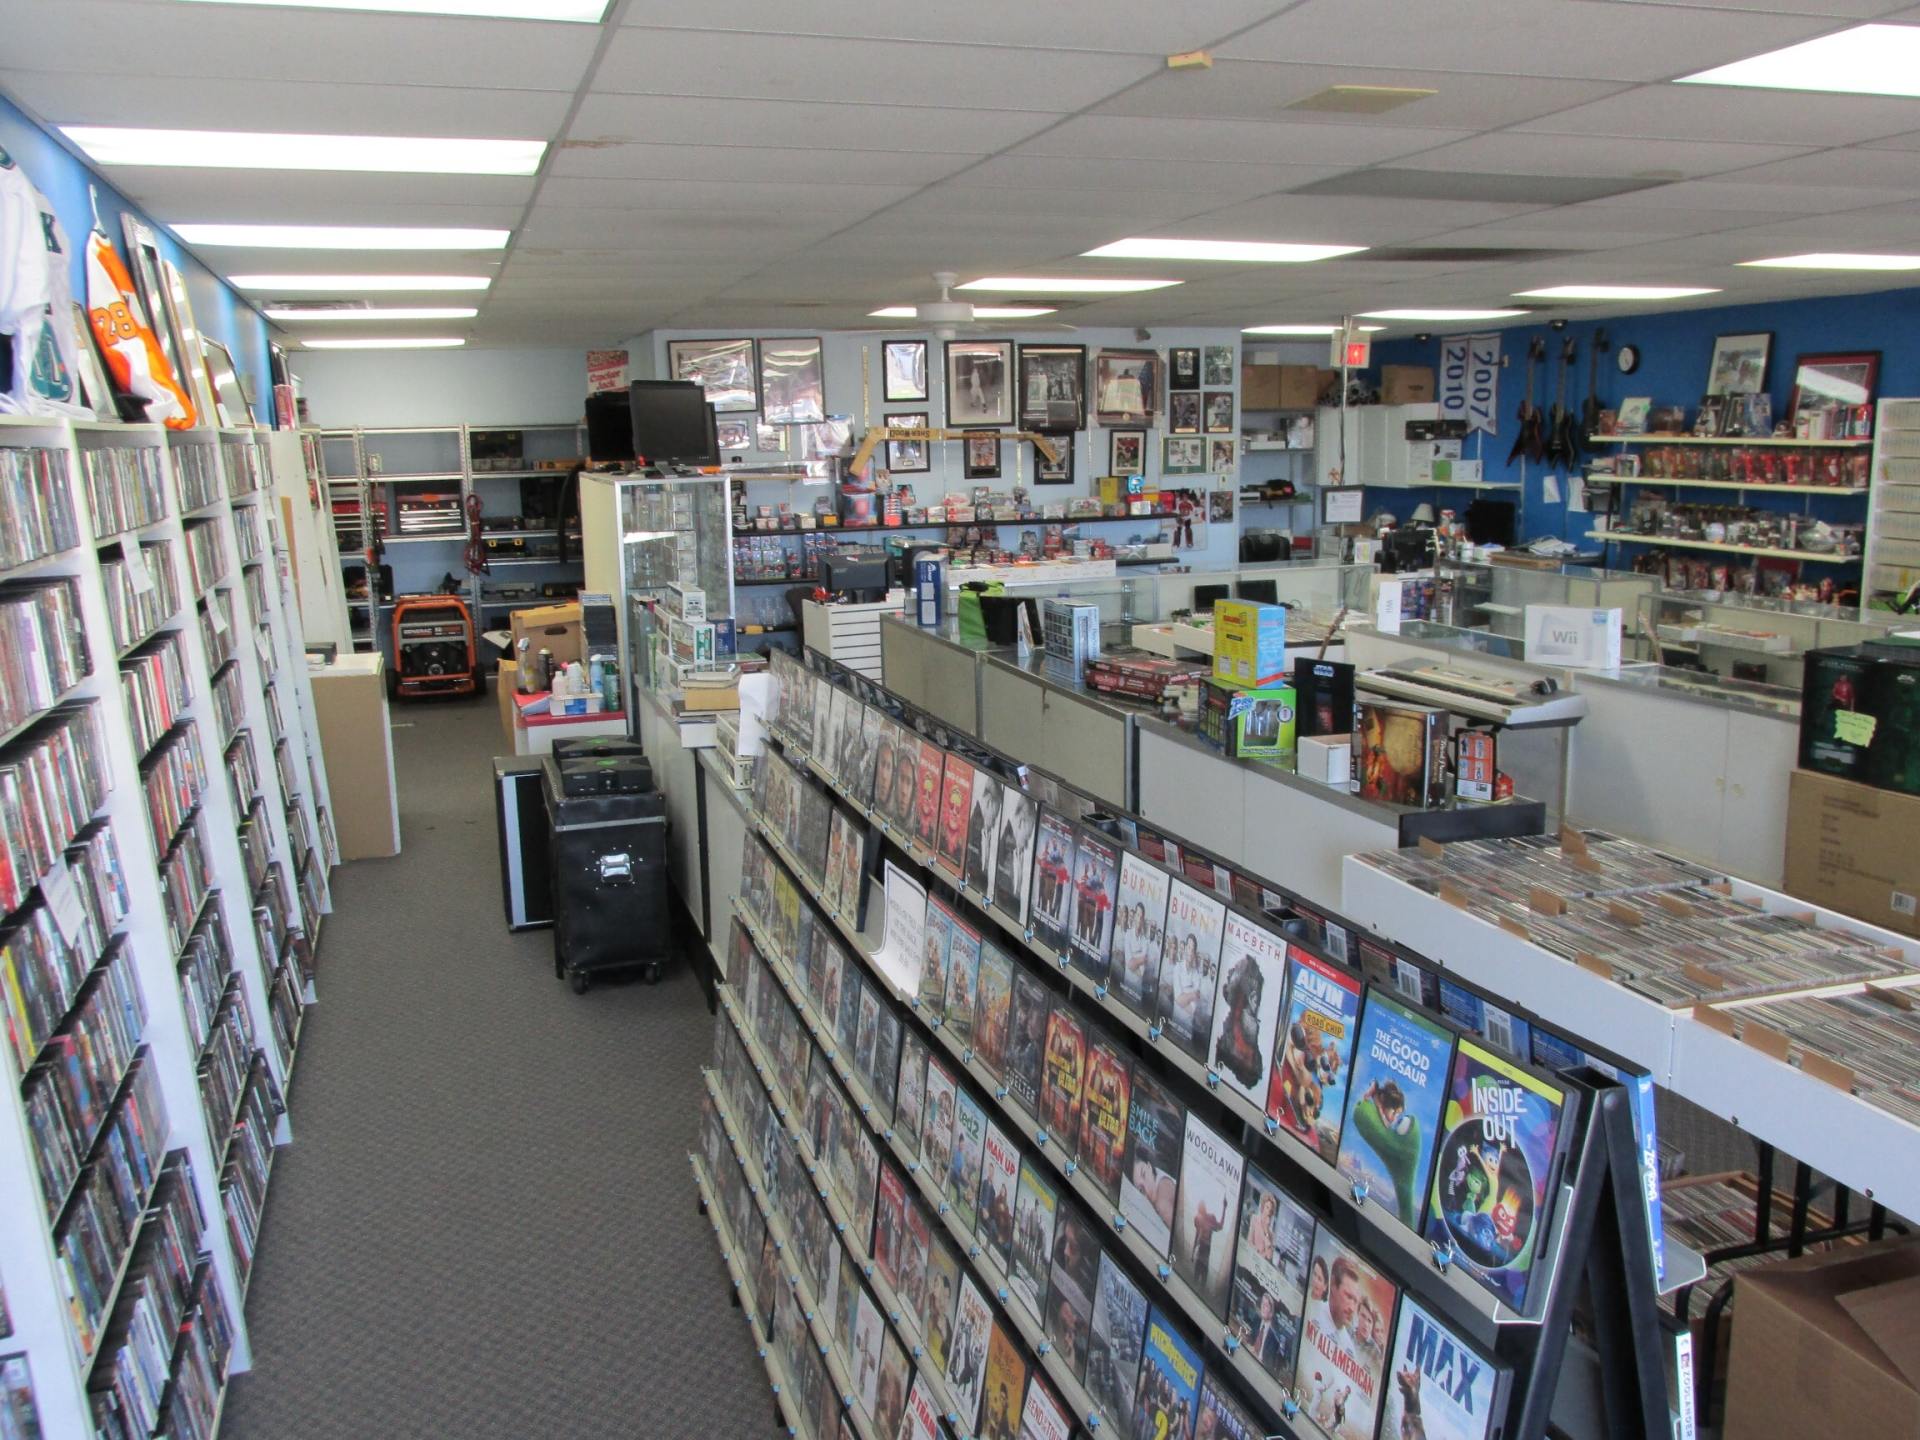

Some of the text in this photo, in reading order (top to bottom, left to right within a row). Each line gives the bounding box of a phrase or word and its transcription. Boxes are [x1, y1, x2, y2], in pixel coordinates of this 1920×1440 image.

[91, 301, 138, 347] 28
[1444, 346, 1466, 411] 2010
[1470, 351, 1493, 419] 2007
[1552, 629, 1579, 645] Wii
[1227, 922, 1281, 960] MACBETH
[1295, 968, 1344, 1009] ALVIN
[1306, 1013, 1343, 1036] ROAD CHIP
[1371, 1045, 1427, 1088] DINOSAUR
[1375, 1027, 1430, 1071] THE GOOD
[1471, 1077, 1528, 1114] INSIDE
[1128, 1116, 1157, 1150] BACK
[1130, 1102, 1160, 1135] SMILE
[1482, 1115, 1519, 1149] OUT
[986, 1138, 1016, 1177] MAN UP
[1185, 1127, 1241, 1184] WOODLAWN
[1306, 1320, 1375, 1400] MY ALL-AMERICAN
[1406, 1312, 1481, 1416] MAX
